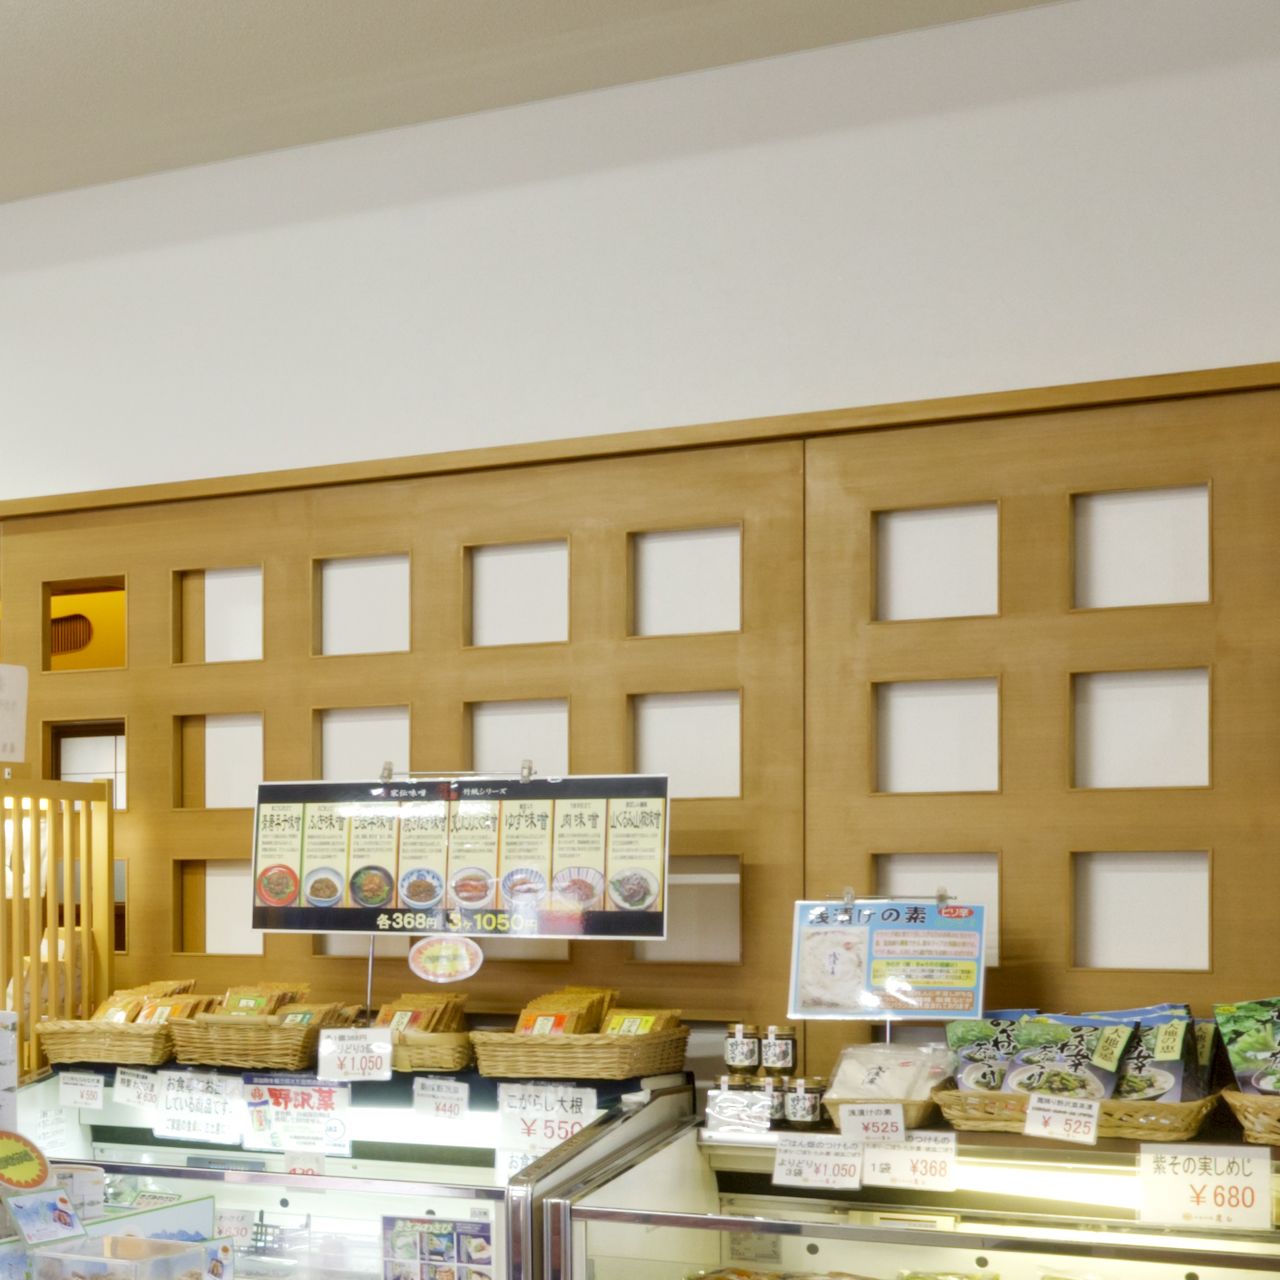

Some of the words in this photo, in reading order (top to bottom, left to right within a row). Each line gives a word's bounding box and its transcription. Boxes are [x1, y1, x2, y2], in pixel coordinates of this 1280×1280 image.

[560, 812, 600, 829] 肉味噌
[376, 911, 438, 930] 各368円
[940, 906, 970, 918] ピリ辛
[267, 1086, 337, 1112] 野沢菜
[506, 1092, 584, 1116] こがらし大根
[434, 1101, 460, 1116] ¥440
[862, 1121, 899, 1133] ¥525
[778, 1158, 814, 1168] よりどり
[910, 1159, 948, 1177] ¥368
[1152, 1154, 1254, 1178] 紫その実しめじ
[1189, 1183, 1255, 1209] ¥680
